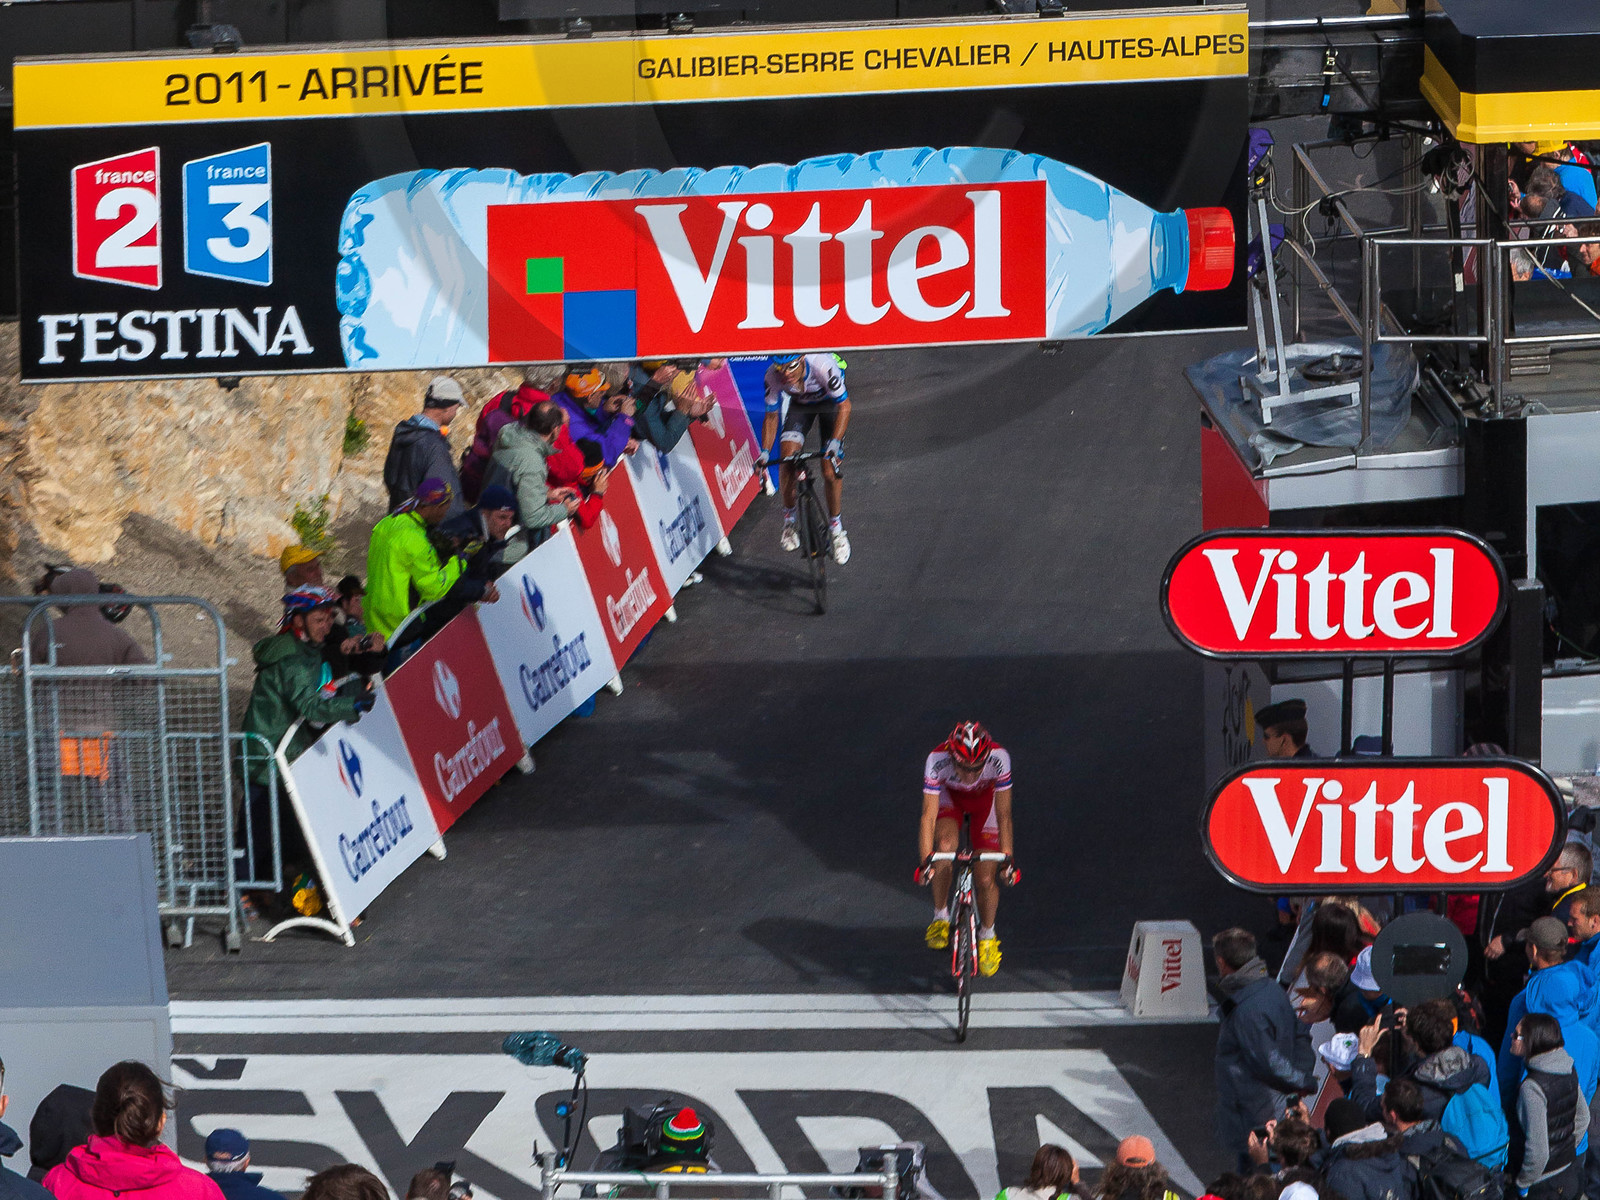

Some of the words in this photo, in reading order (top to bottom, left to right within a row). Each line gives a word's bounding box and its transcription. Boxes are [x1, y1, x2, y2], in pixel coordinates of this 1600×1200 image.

[637, 50, 855, 80] GALIBIER-SERRE
[864, 43, 1011, 71] CHEVALIER
[1020, 42, 1039, 66] /
[1047, 33, 1246, 63] HAUTES-ALPES
[95, 169, 156, 185] france
[206, 165, 266, 180] france
[95, 187, 160, 269] 2
[206, 184, 270, 264] 3
[635, 190, 1011, 335] Vittel
[38, 305, 314, 365] FESTINA
[1202, 547, 1458, 642] Vittel
[519, 630, 592, 713] Carrefour
[434, 716, 506, 803] Carrefour
[338, 794, 414, 883] Carrefour
[1241, 777, 1514, 875] Vittel
[1160, 938, 1182, 995] Vittel
